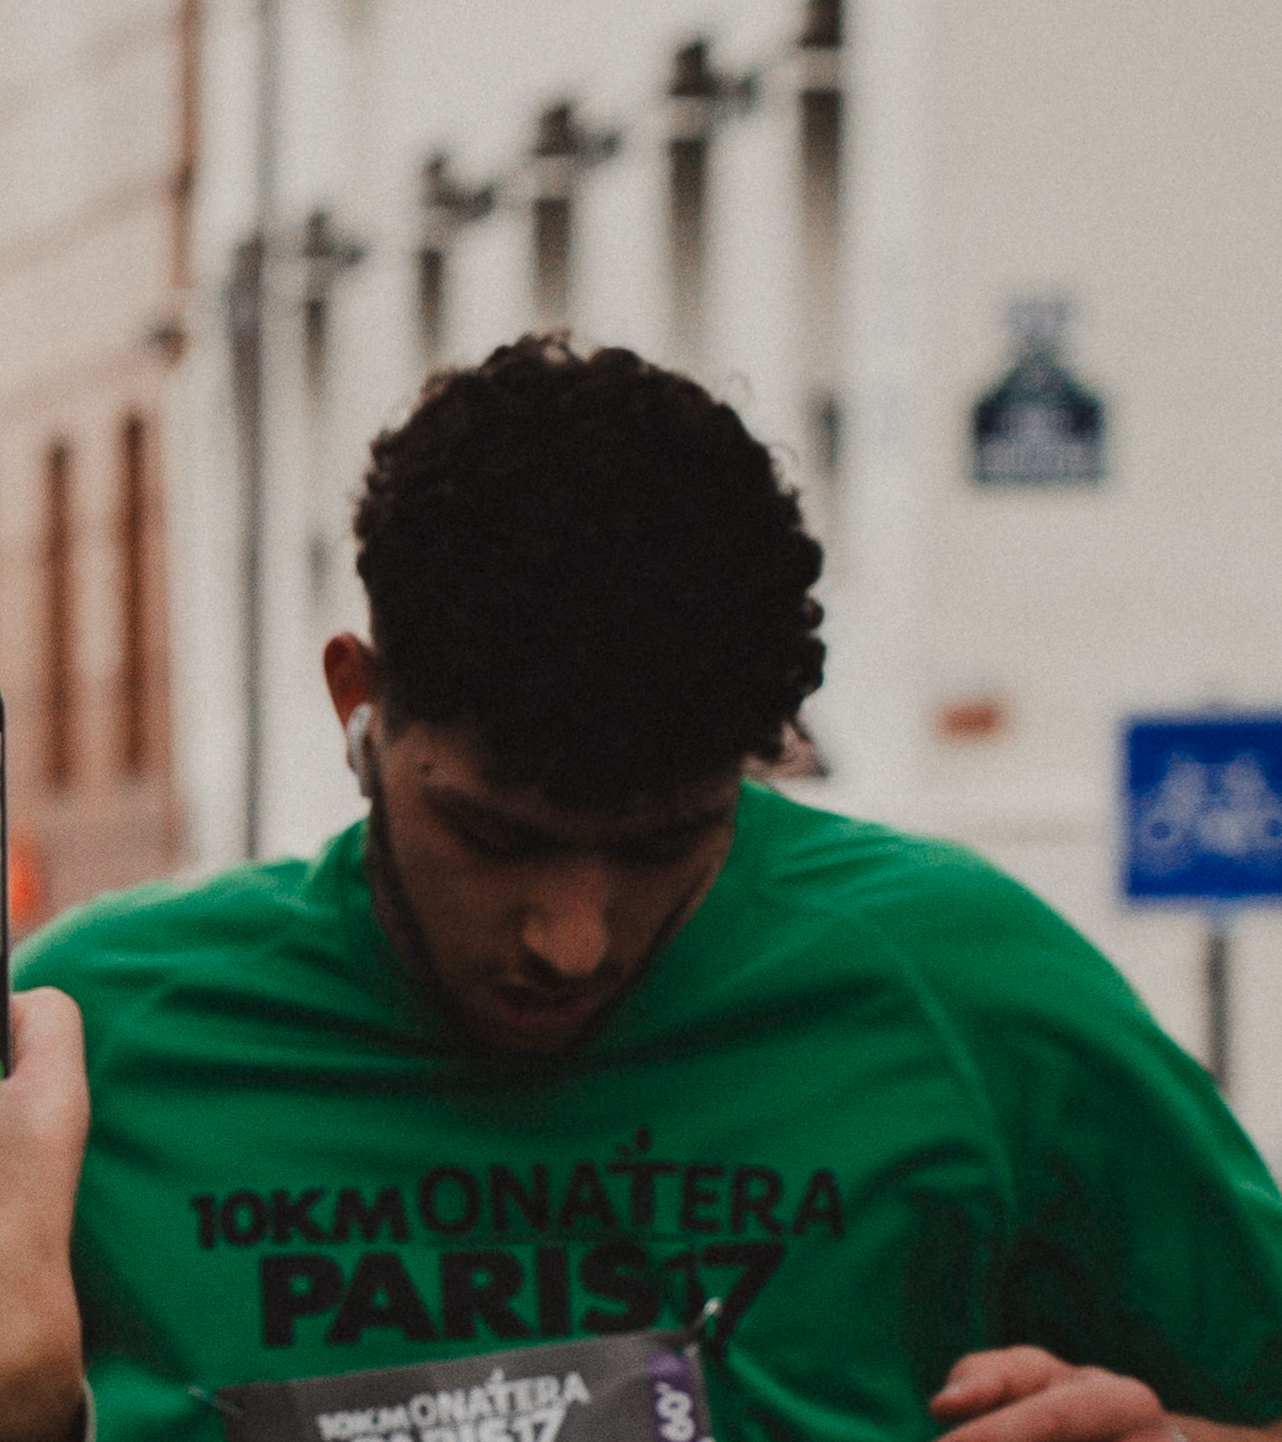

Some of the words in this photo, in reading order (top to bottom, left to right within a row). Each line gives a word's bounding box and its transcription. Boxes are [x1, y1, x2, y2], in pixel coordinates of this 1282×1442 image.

[191, 1186, 410, 1250] 10KM
[417, 1158, 844, 1240] ONATERA
[409, 1373, 591, 1426] ONATERA
